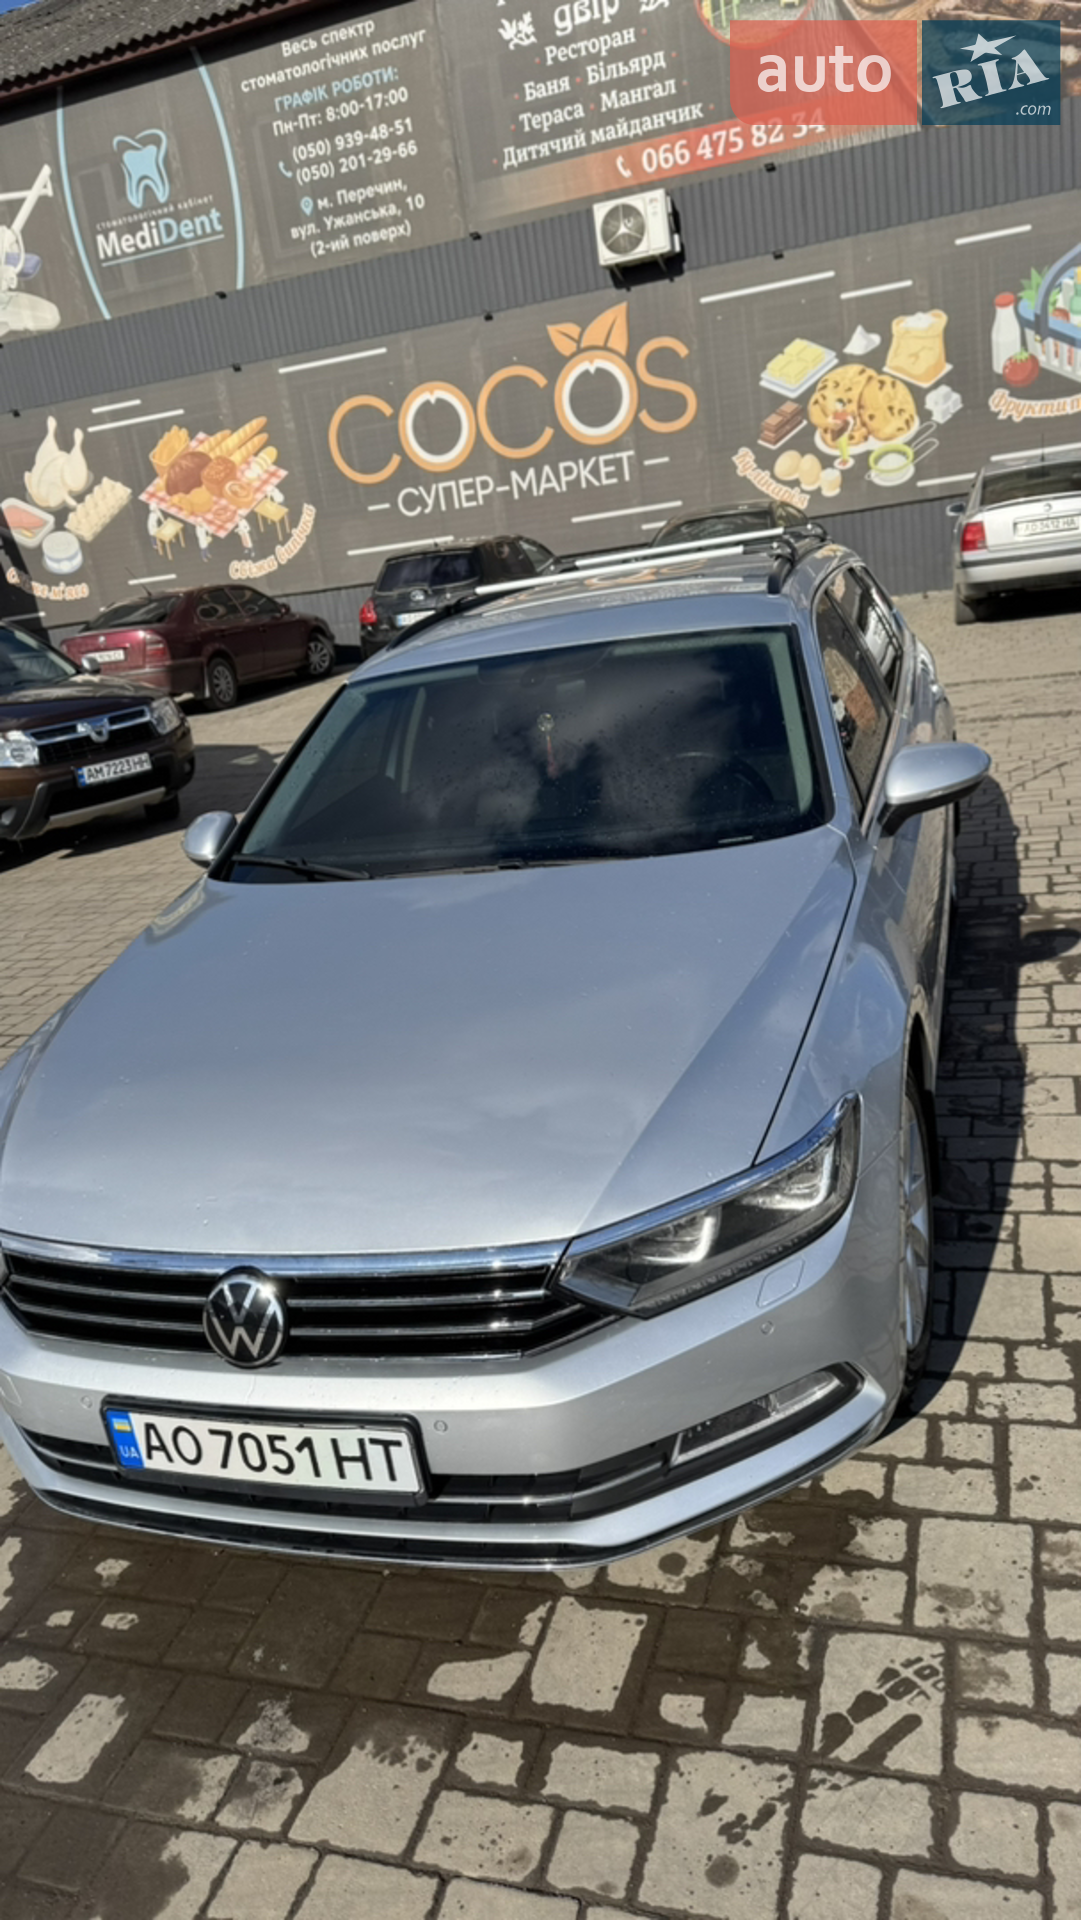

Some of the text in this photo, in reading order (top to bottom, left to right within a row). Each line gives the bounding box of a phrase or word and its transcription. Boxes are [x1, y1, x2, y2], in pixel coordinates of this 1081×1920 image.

[241, 30, 426, 92] стоматологічних послуг
[281, 20, 375, 57] Весь спектр
[544, 27, 637, 66] Ресторан
[274, 66, 399, 113] ГРАФІК РОБОТИ:
[523, 51, 667, 102] Баня Більярд
[273, 87, 408, 136] Пн-Пт: 8:00-17:00
[518, 79, 677, 132] Тераса Мангал
[293, 117, 413, 163] (050) 939-48-51
[502, 103, 704, 170] Дитячий майданчик
[642, 139, 690, 173] 066
[696, 126, 744, 160] 475
[751, 117, 785, 148] 82
[296, 140, 417, 185] (050) 201-29-66
[290, 193, 425, 241] вул. Ужанська, 10
[317, 179, 408, 210] м. Перечин,
[96, 207, 223, 260] MediDent
[310, 219, 411, 258] (2-ий поверх)
[329, 336, 698, 484] COCOS
[988, 388, 1067, 422] Фрукти
[397, 450, 635, 517] СУПЕР-МАРКЕТ
[119, 1445, 140, 1460] UA
[208, 1427, 321, 1480] 7051
